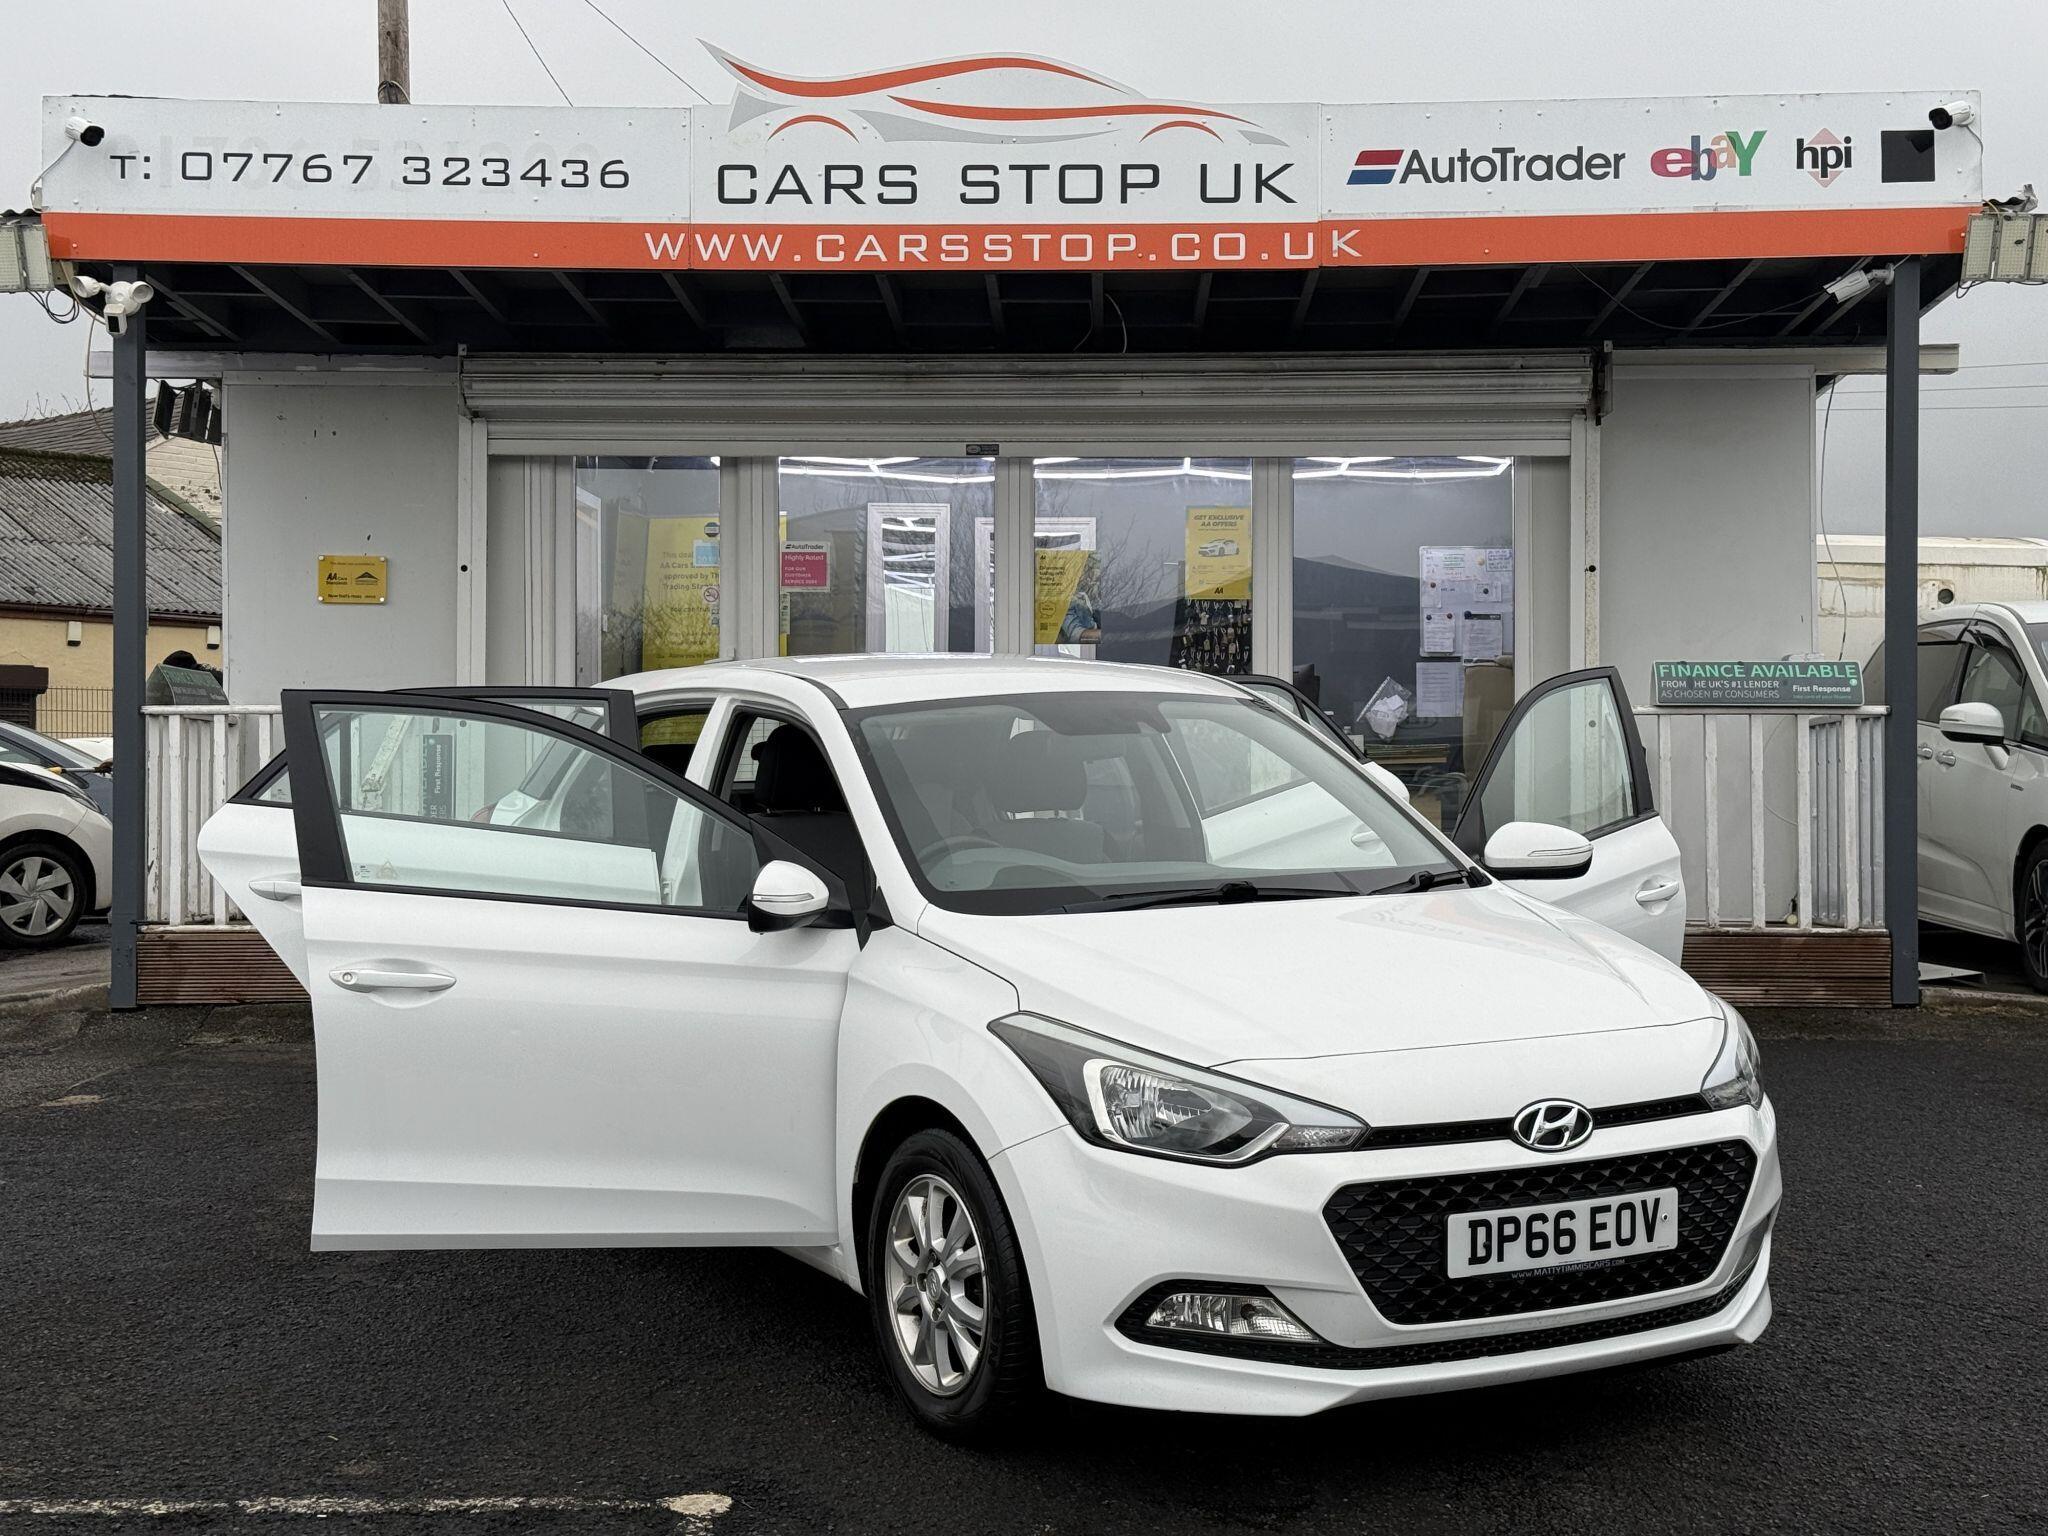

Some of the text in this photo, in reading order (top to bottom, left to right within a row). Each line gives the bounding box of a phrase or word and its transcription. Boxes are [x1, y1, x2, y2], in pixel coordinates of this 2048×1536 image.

[110, 152, 630, 189] T: 07767 323436
[1399, 146, 1626, 184] AutoTrader
[1796, 137, 1852, 179] hpi
[717, 163, 1297, 205] CARS STOP UK
[645, 230, 1362, 264] WWW.CARSSTOP.CO.UK
[1659, 664, 1858, 679] FINANCE AVAILABLE
[1661, 680, 1687, 688] FROM
[1689, 680, 1707, 688] HE
[1708, 680, 1730, 688] UK'S
[1744, 680, 1780, 688] LENDER
[1792, 684, 1851, 693] First Response
[1661, 690, 1780, 699] AS CHOSEN BY CONSUMERS
[1468, 1197, 1661, 1266] DP66 EOV
